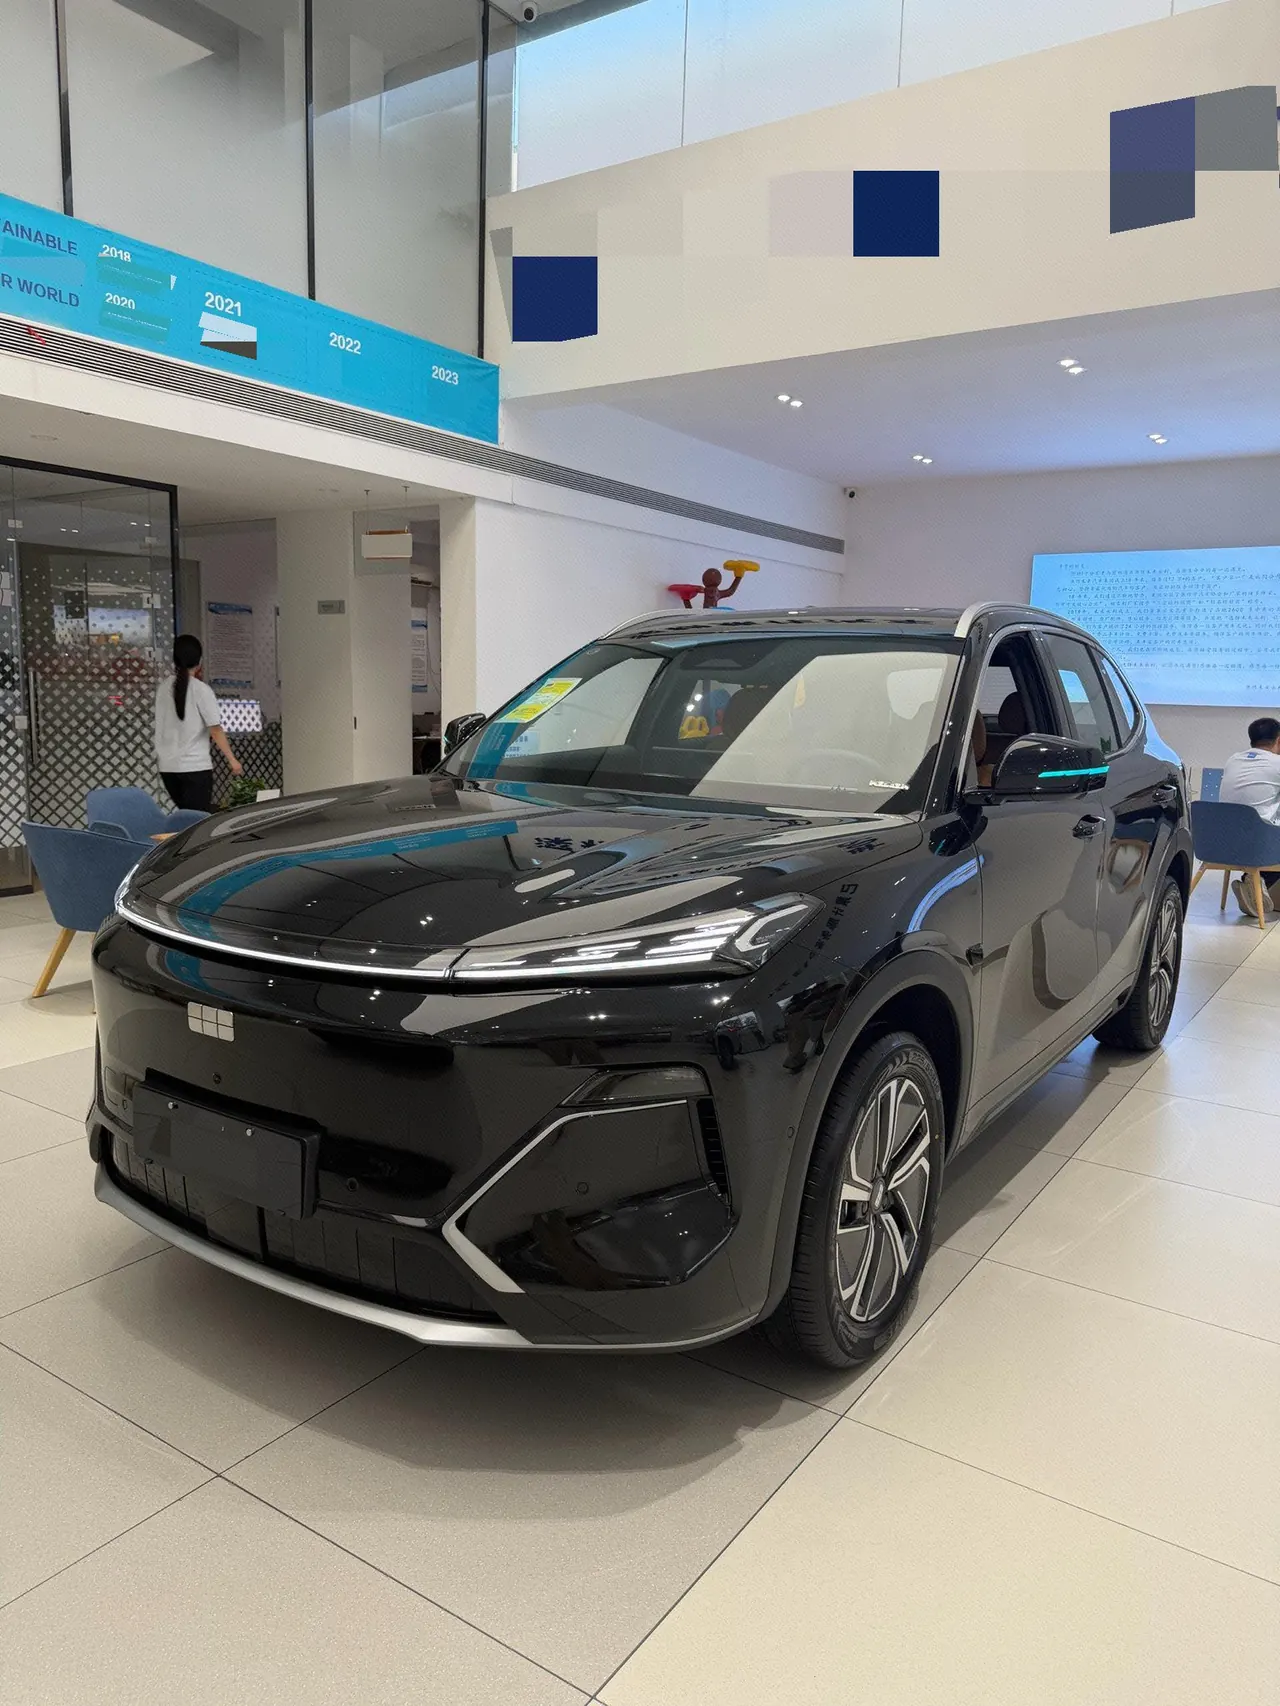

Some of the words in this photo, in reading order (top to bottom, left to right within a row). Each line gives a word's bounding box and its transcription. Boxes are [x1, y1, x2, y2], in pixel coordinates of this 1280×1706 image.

[0, 219, 78, 256] AINABLE
[102, 244, 132, 262] 2018
[17, 277, 80, 308] WORLD
[105, 292, 136, 310] 2020
[204, 291, 242, 317] 2021
[329, 332, 362, 355] 2022
[431, 365, 459, 386] 2023
